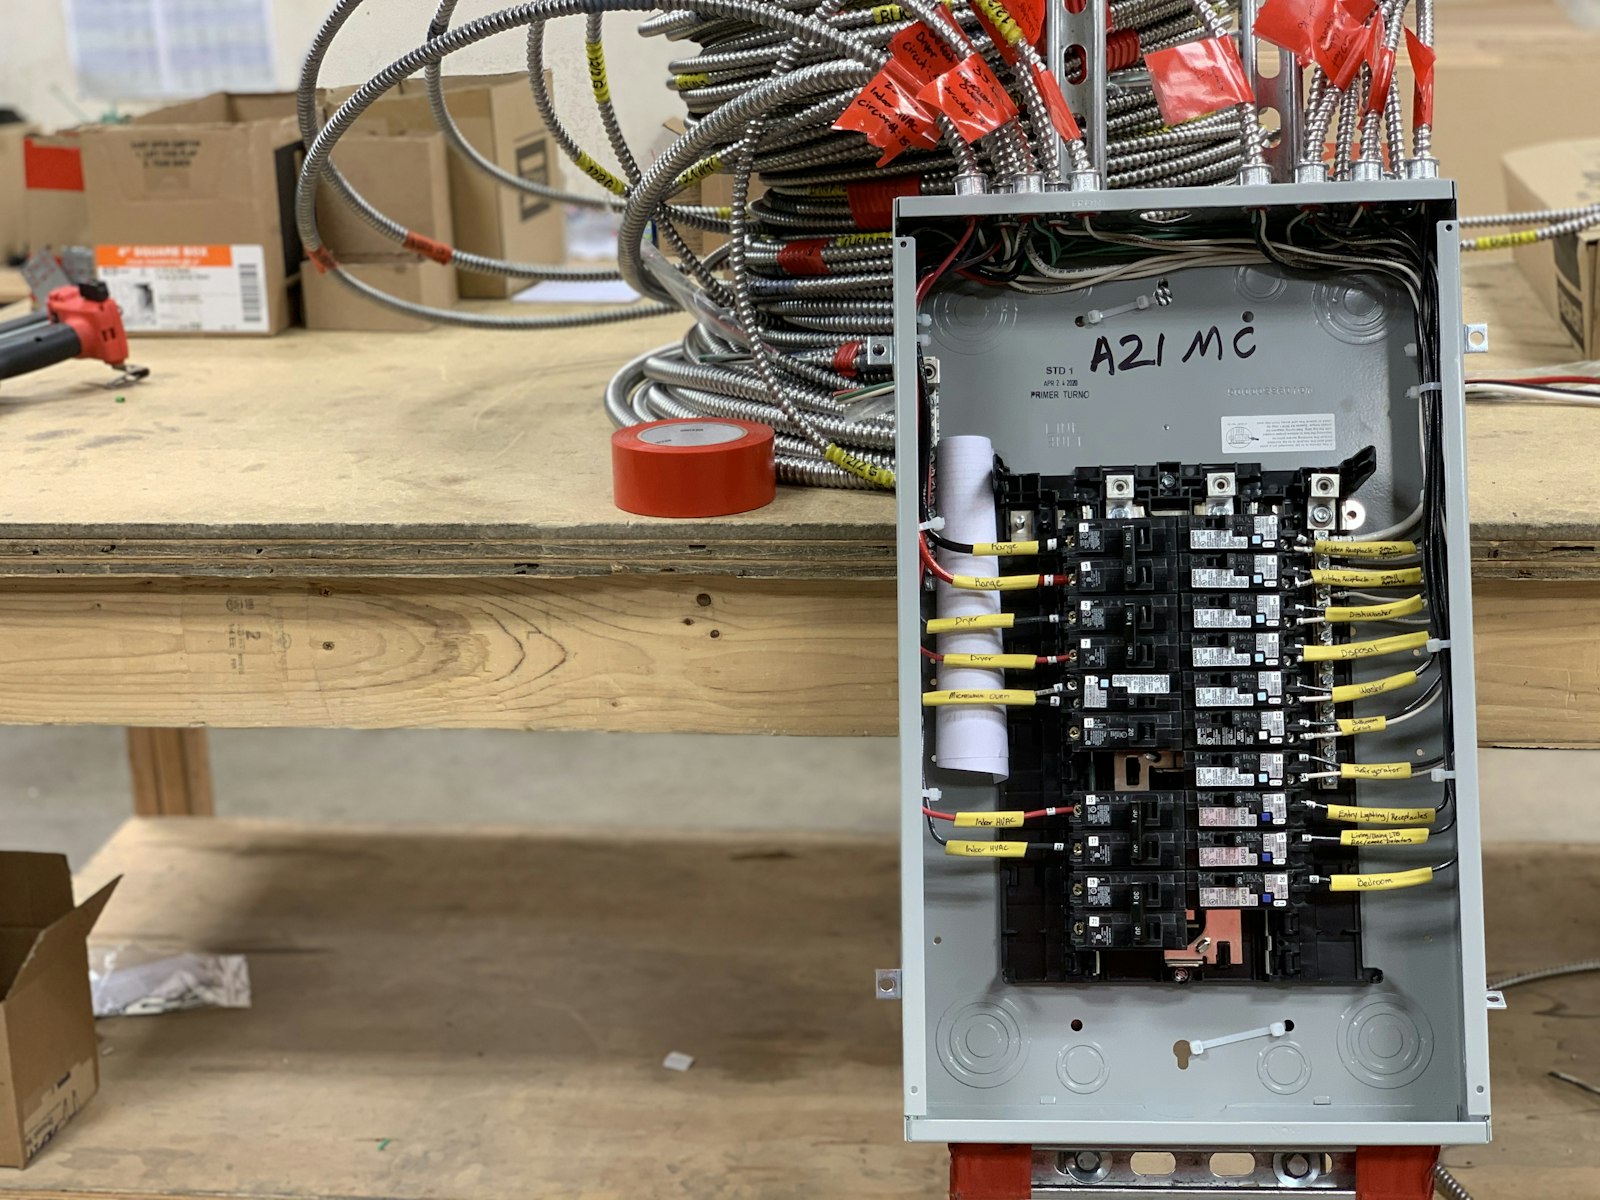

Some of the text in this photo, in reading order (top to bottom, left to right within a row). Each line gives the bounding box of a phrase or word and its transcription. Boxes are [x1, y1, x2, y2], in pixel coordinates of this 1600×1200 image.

[1046, 366, 1074, 375] STD 1
[1030, 391, 1090, 399] PRIMER TURNO
[991, 542, 1018, 554] Range
[974, 578, 1004, 588] Range
[955, 616, 982, 626] Dryer
[1341, 645, 1379, 658] Disposal
[970, 654, 996, 662] Dryer
[1338, 810, 1358, 820] Entry
[996, 818, 1017, 826] HVAC
[1357, 877, 1393, 887] Bedroom
